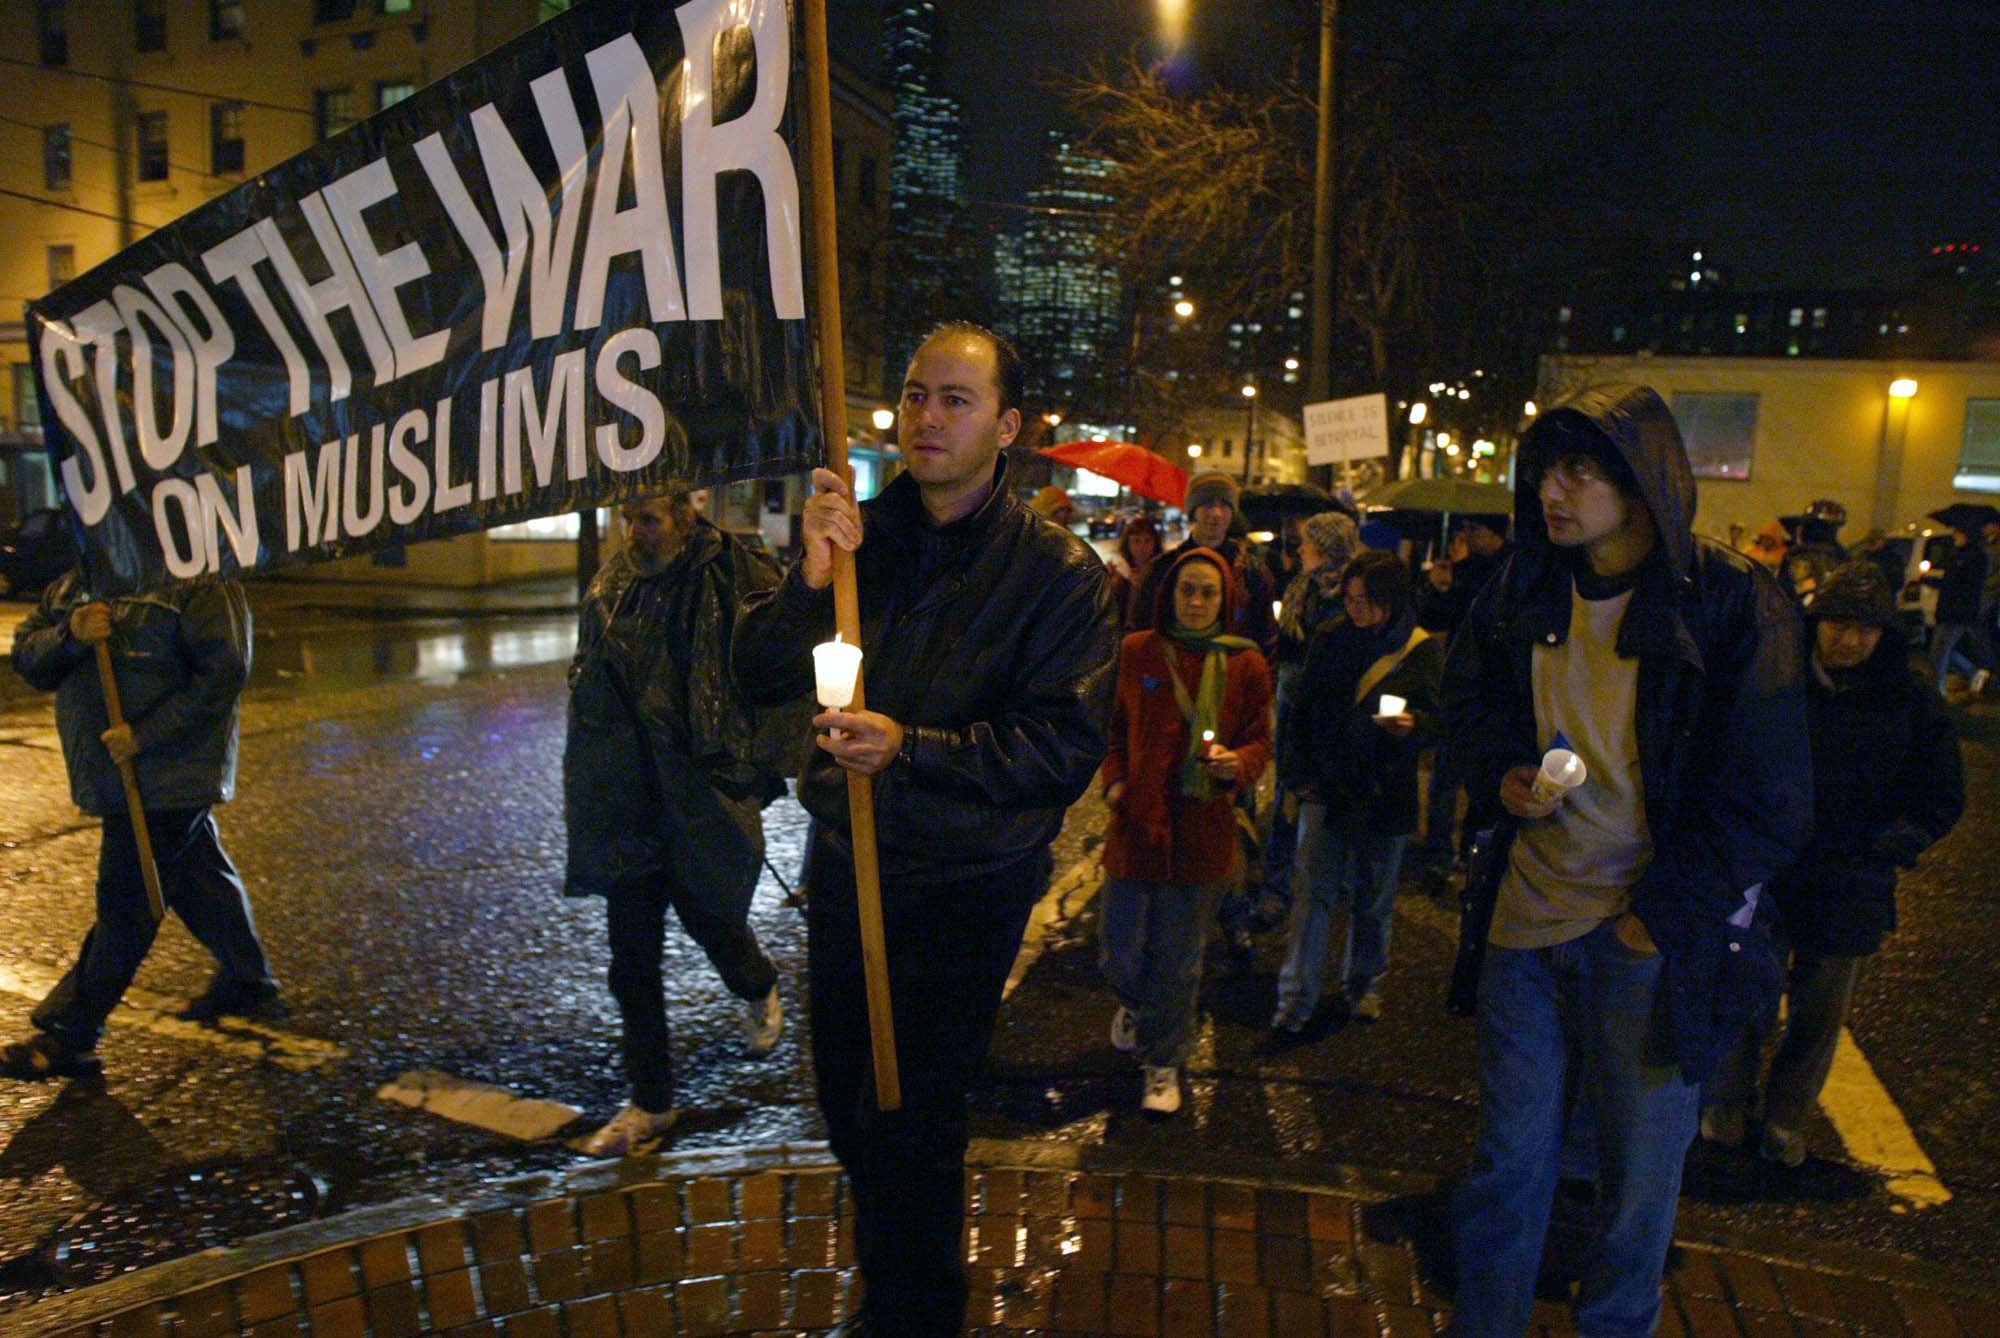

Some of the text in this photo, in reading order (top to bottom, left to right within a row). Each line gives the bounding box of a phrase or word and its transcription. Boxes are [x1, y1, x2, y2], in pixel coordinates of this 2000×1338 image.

[39, 0, 805, 526] STOP THE WAR
[151, 327, 665, 579] ON MUSLIMS
